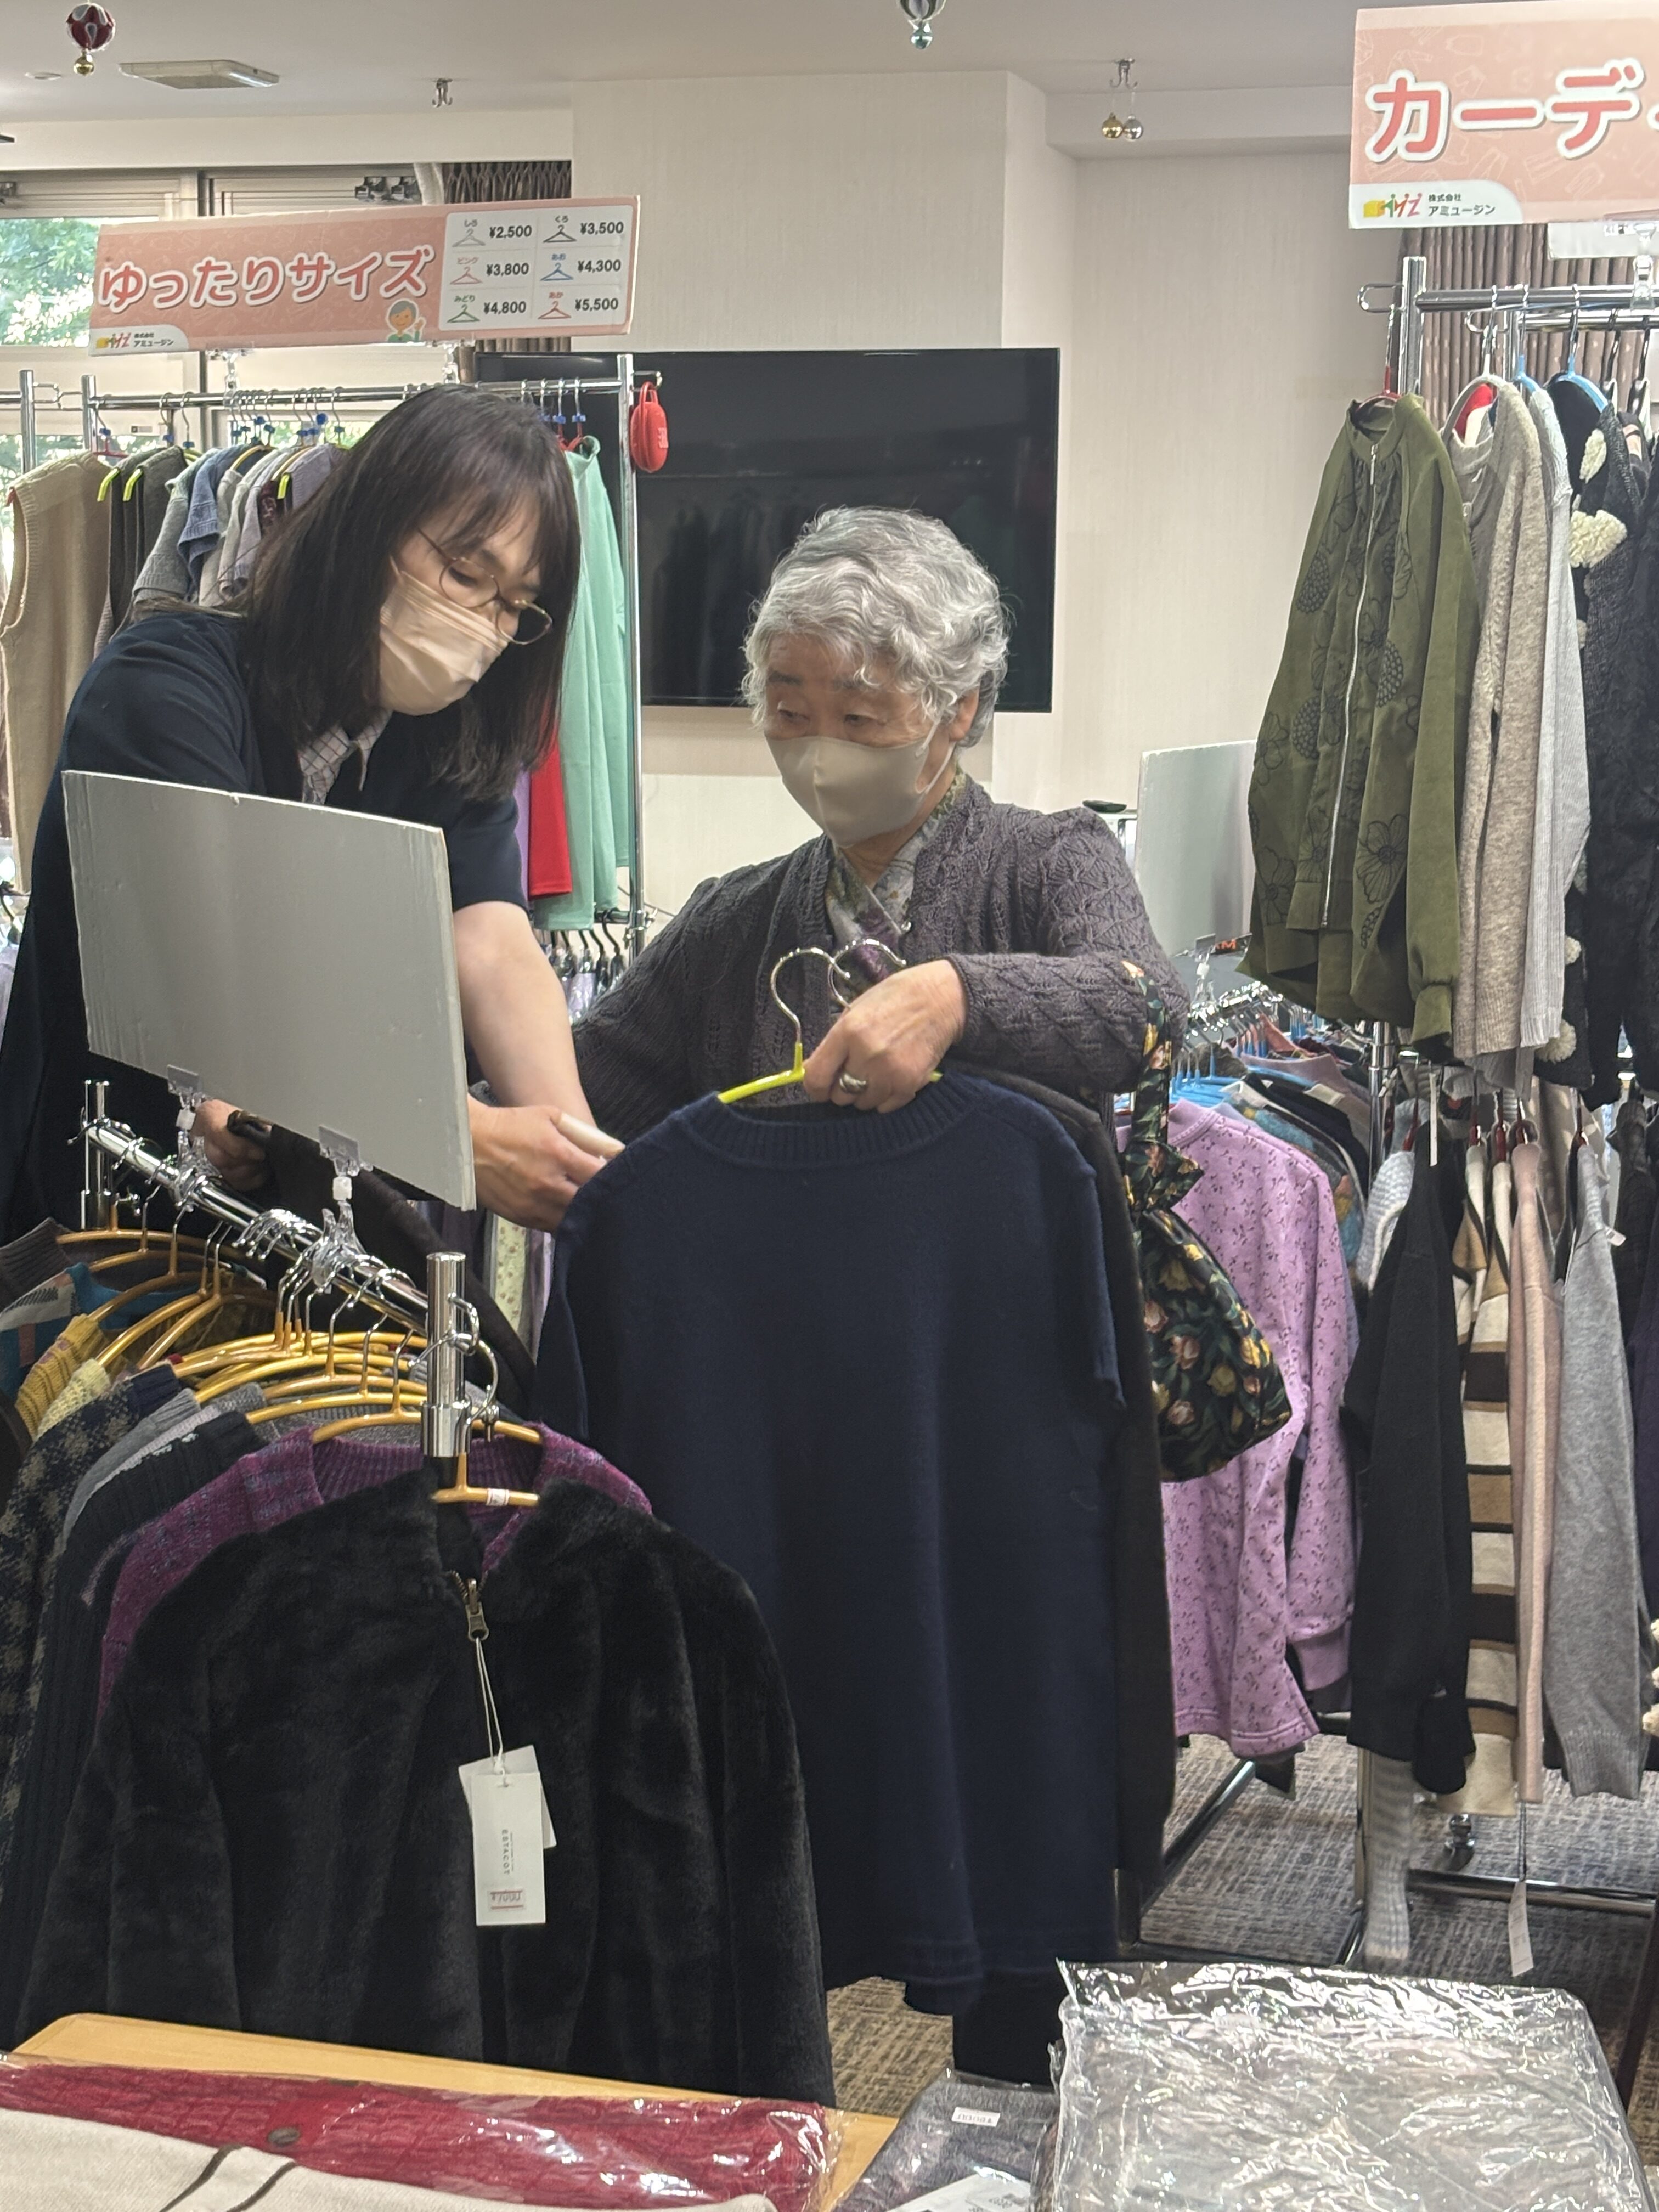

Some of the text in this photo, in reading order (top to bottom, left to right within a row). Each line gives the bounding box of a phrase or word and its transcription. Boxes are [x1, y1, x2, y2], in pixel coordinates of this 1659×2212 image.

[1368, 58, 1659, 160] カーデ
[1428, 193, 1462, 202] 株式会社
[1428, 204, 1496, 216] アミュージン
[489, 225, 532, 238] ¥2,500
[580, 222, 624, 234] ¥3,500
[486, 263, 529, 276] ¥3,800
[578, 259, 621, 272] ¥4,300
[100, 246, 432, 312] ゆったりサイズ
[483, 301, 527, 314] ¥4,800
[575, 298, 619, 311] ¥5,500
